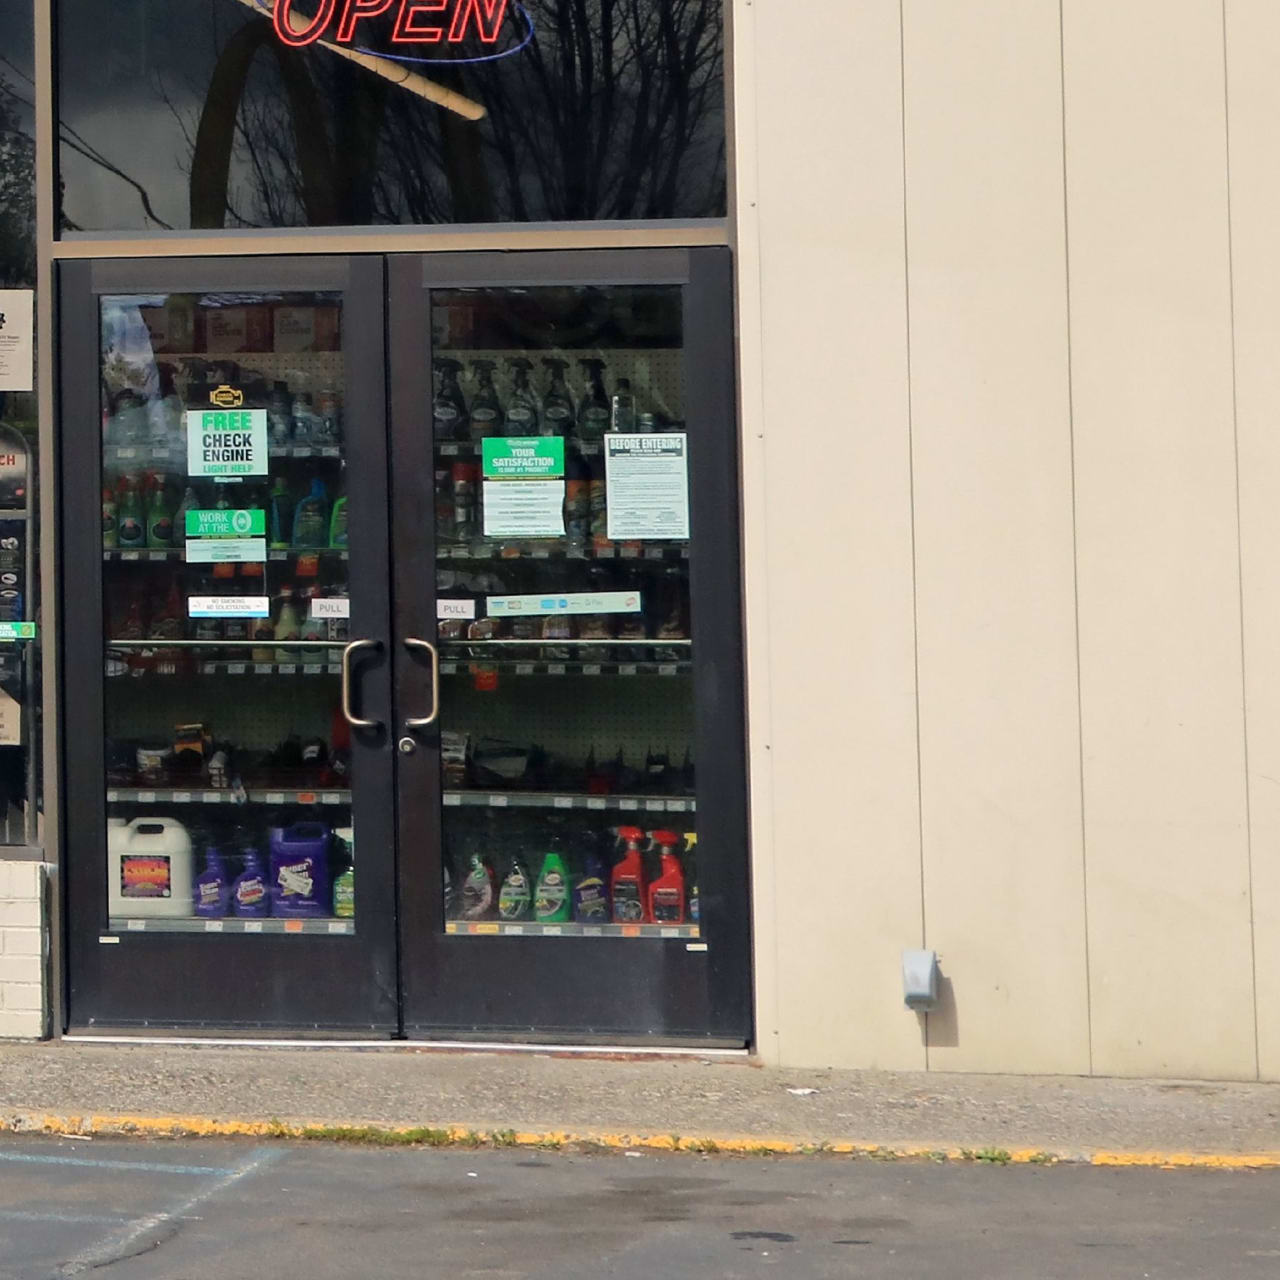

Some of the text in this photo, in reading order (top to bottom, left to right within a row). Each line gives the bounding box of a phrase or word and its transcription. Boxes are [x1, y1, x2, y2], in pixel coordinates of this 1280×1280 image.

[202, 412, 252, 430] FREE
[202, 433, 252, 448] CHECK
[610, 438, 681, 449] BEFORE ENTERING
[203, 449, 252, 462] ENGINE
[511, 448, 535, 457] YOUR
[492, 457, 554, 467] SATISFACTION
[203, 464, 253, 473] LIGHT HELP
[198, 512, 229, 522] WORK
[198, 523, 210, 532] AT
[212, 523, 229, 532] THE
[319, 604, 342, 613] PULL
[443, 604, 467, 614] PULL
